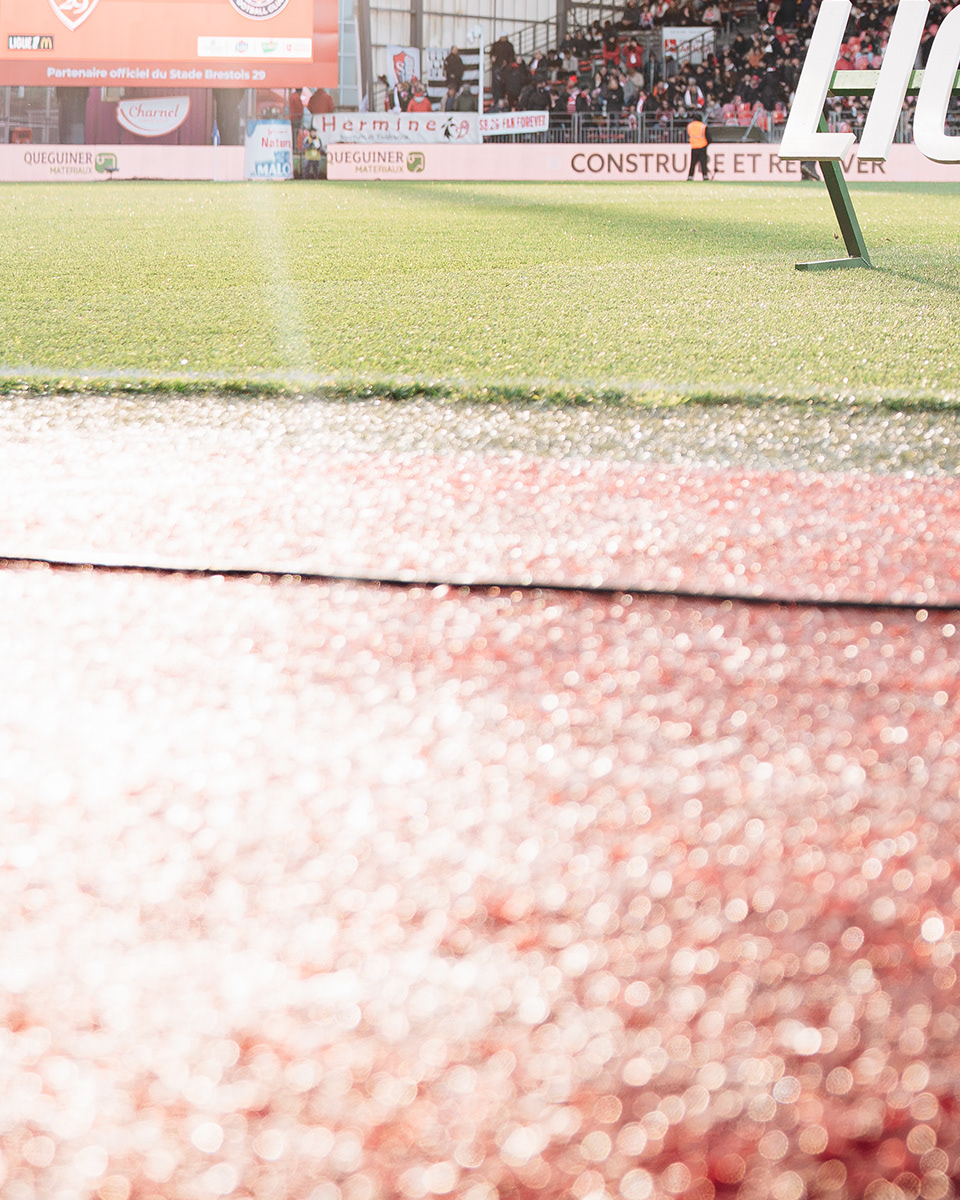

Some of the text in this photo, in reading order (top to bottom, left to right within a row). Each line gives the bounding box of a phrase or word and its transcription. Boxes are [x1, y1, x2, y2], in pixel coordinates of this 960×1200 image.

[47, 66, 267, 81] Partenaire officiel du Stade Brestois 29
[129, 103, 180, 118] Charnel
[322, 115, 437, 134] Hermine
[24, 151, 93, 167] QUEGUINER
[734, 153, 762, 173] ET
[50, 166, 93, 175] MATERIAUX
[255, 162, 292, 177] MALO
[355, 166, 404, 175] MATERIAUX
